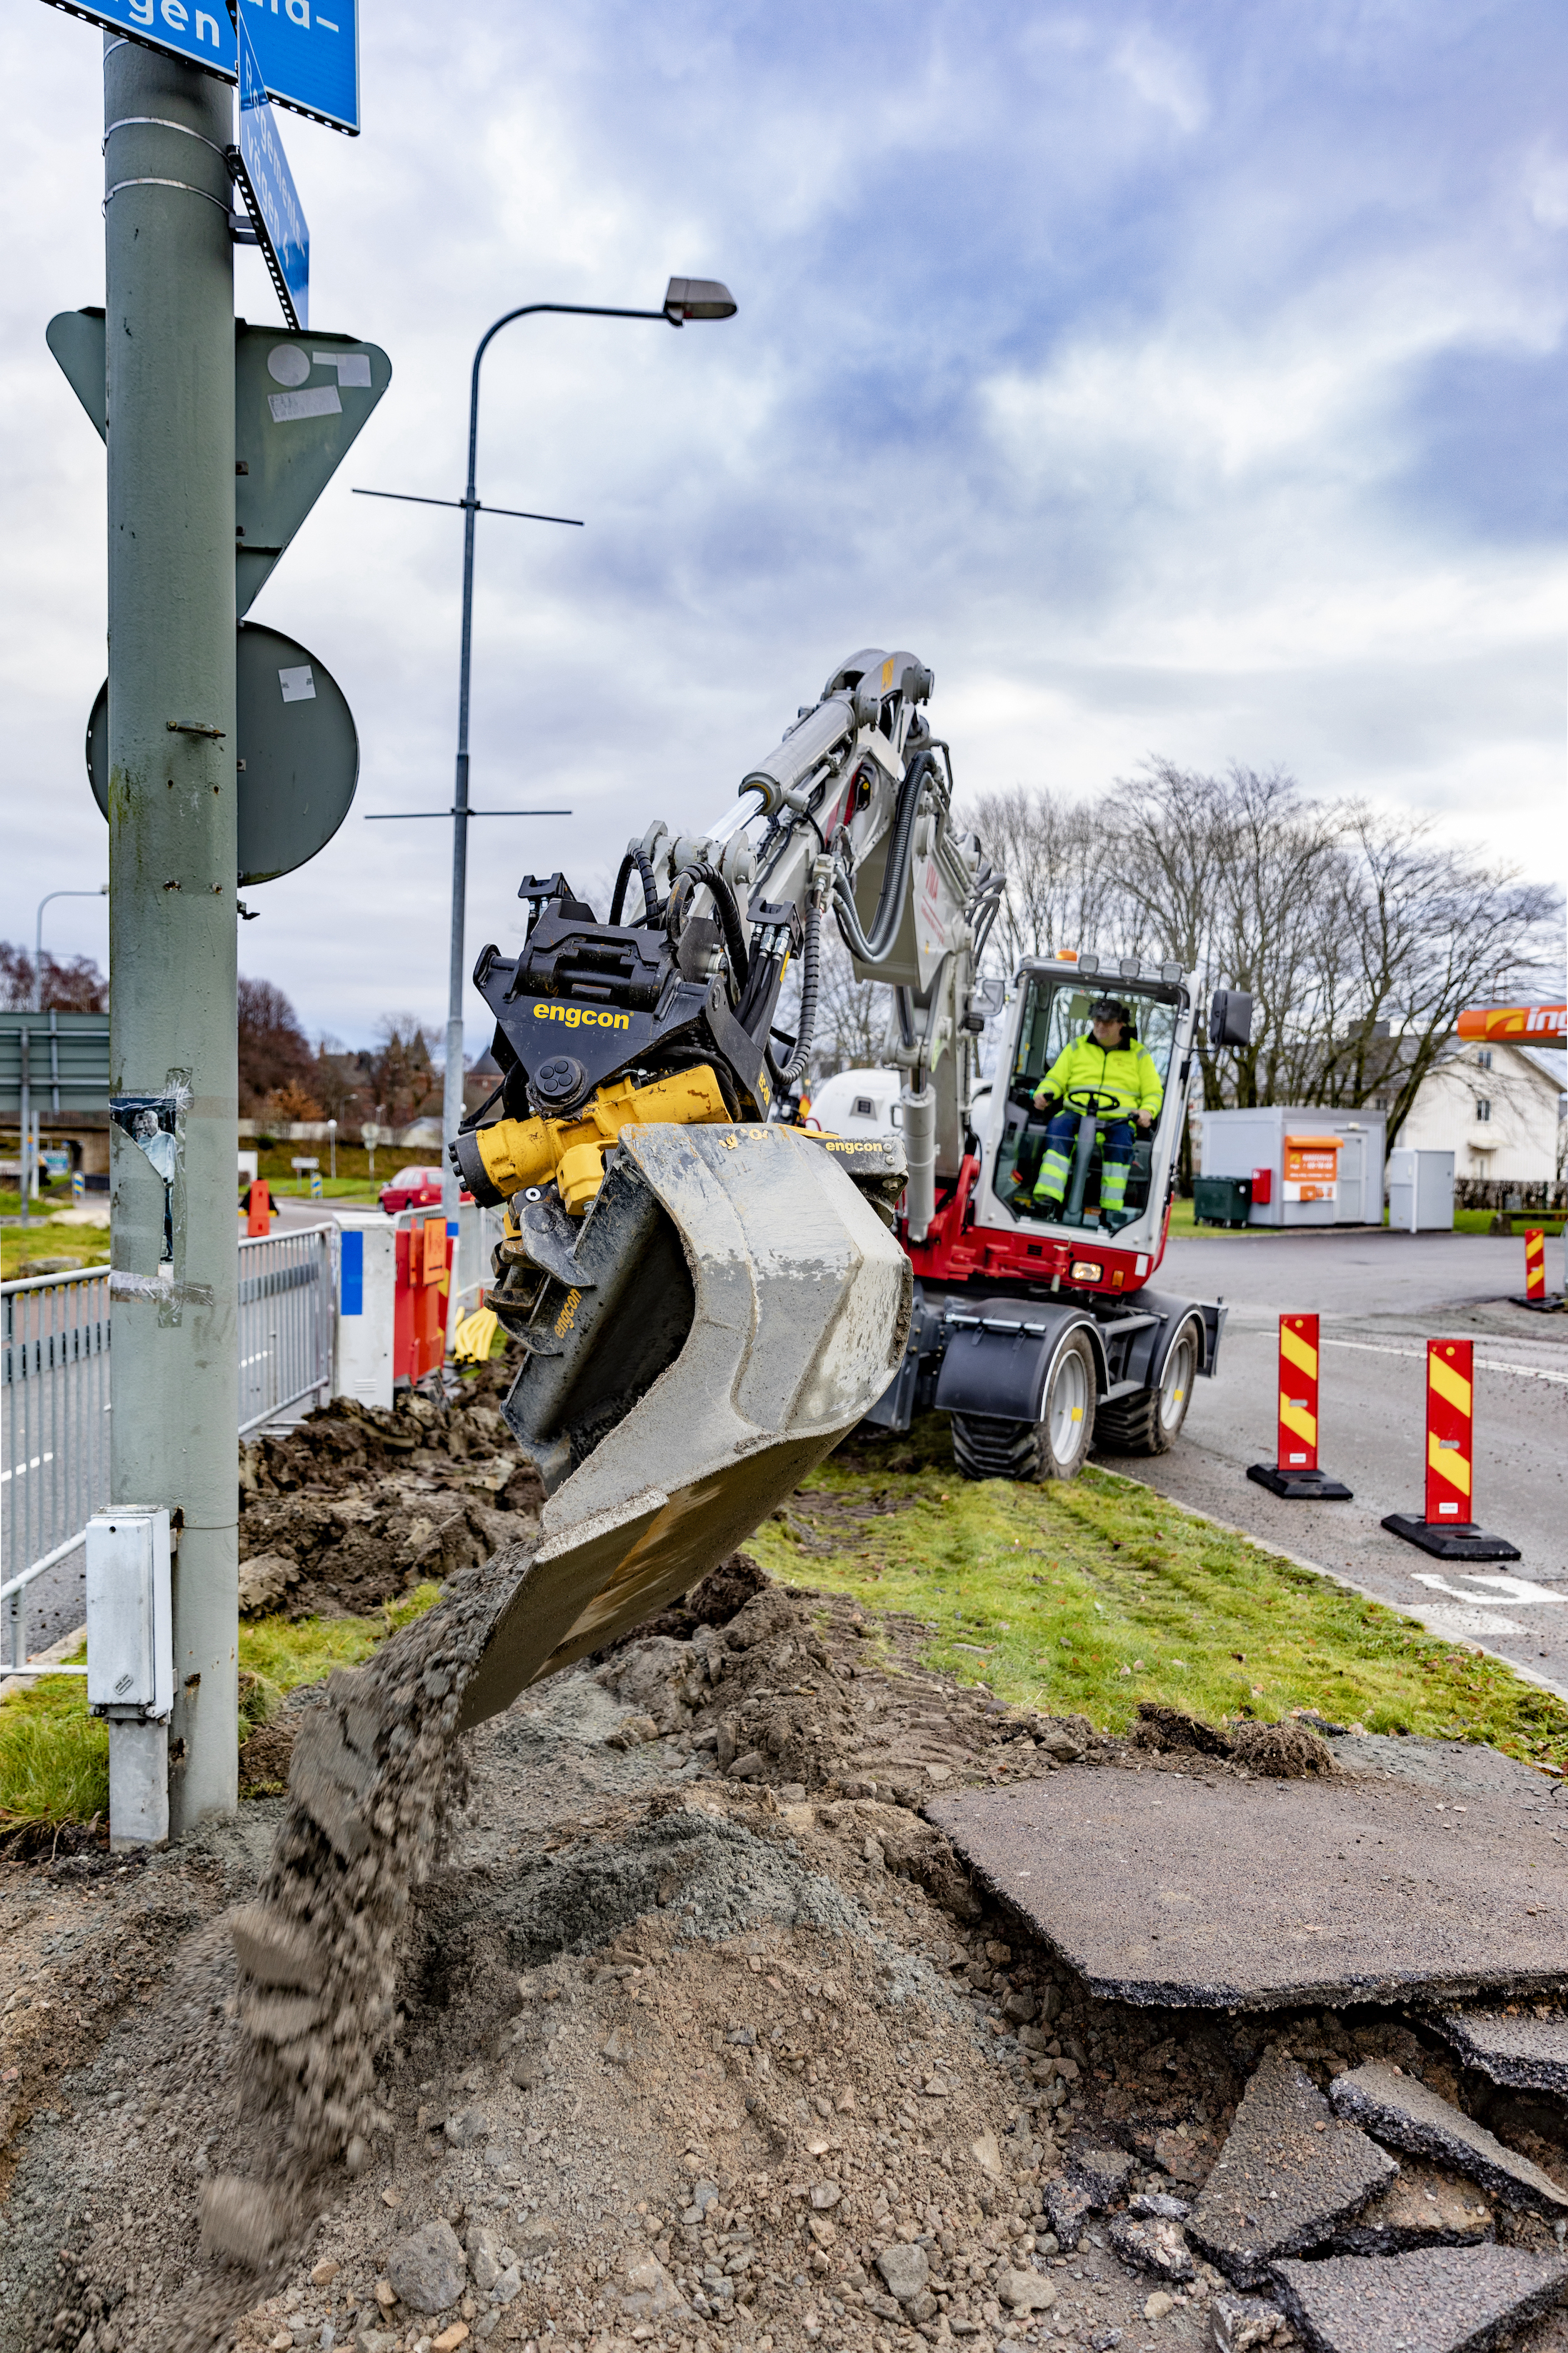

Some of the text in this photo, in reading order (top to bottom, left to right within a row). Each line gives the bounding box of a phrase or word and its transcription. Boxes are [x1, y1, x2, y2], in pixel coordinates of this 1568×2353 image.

[245, 49, 306, 259] Regements-
[246, 124, 281, 247] vägen
[826, 1141, 883, 1154] engcon
[554, 1288, 582, 1339] engcon
